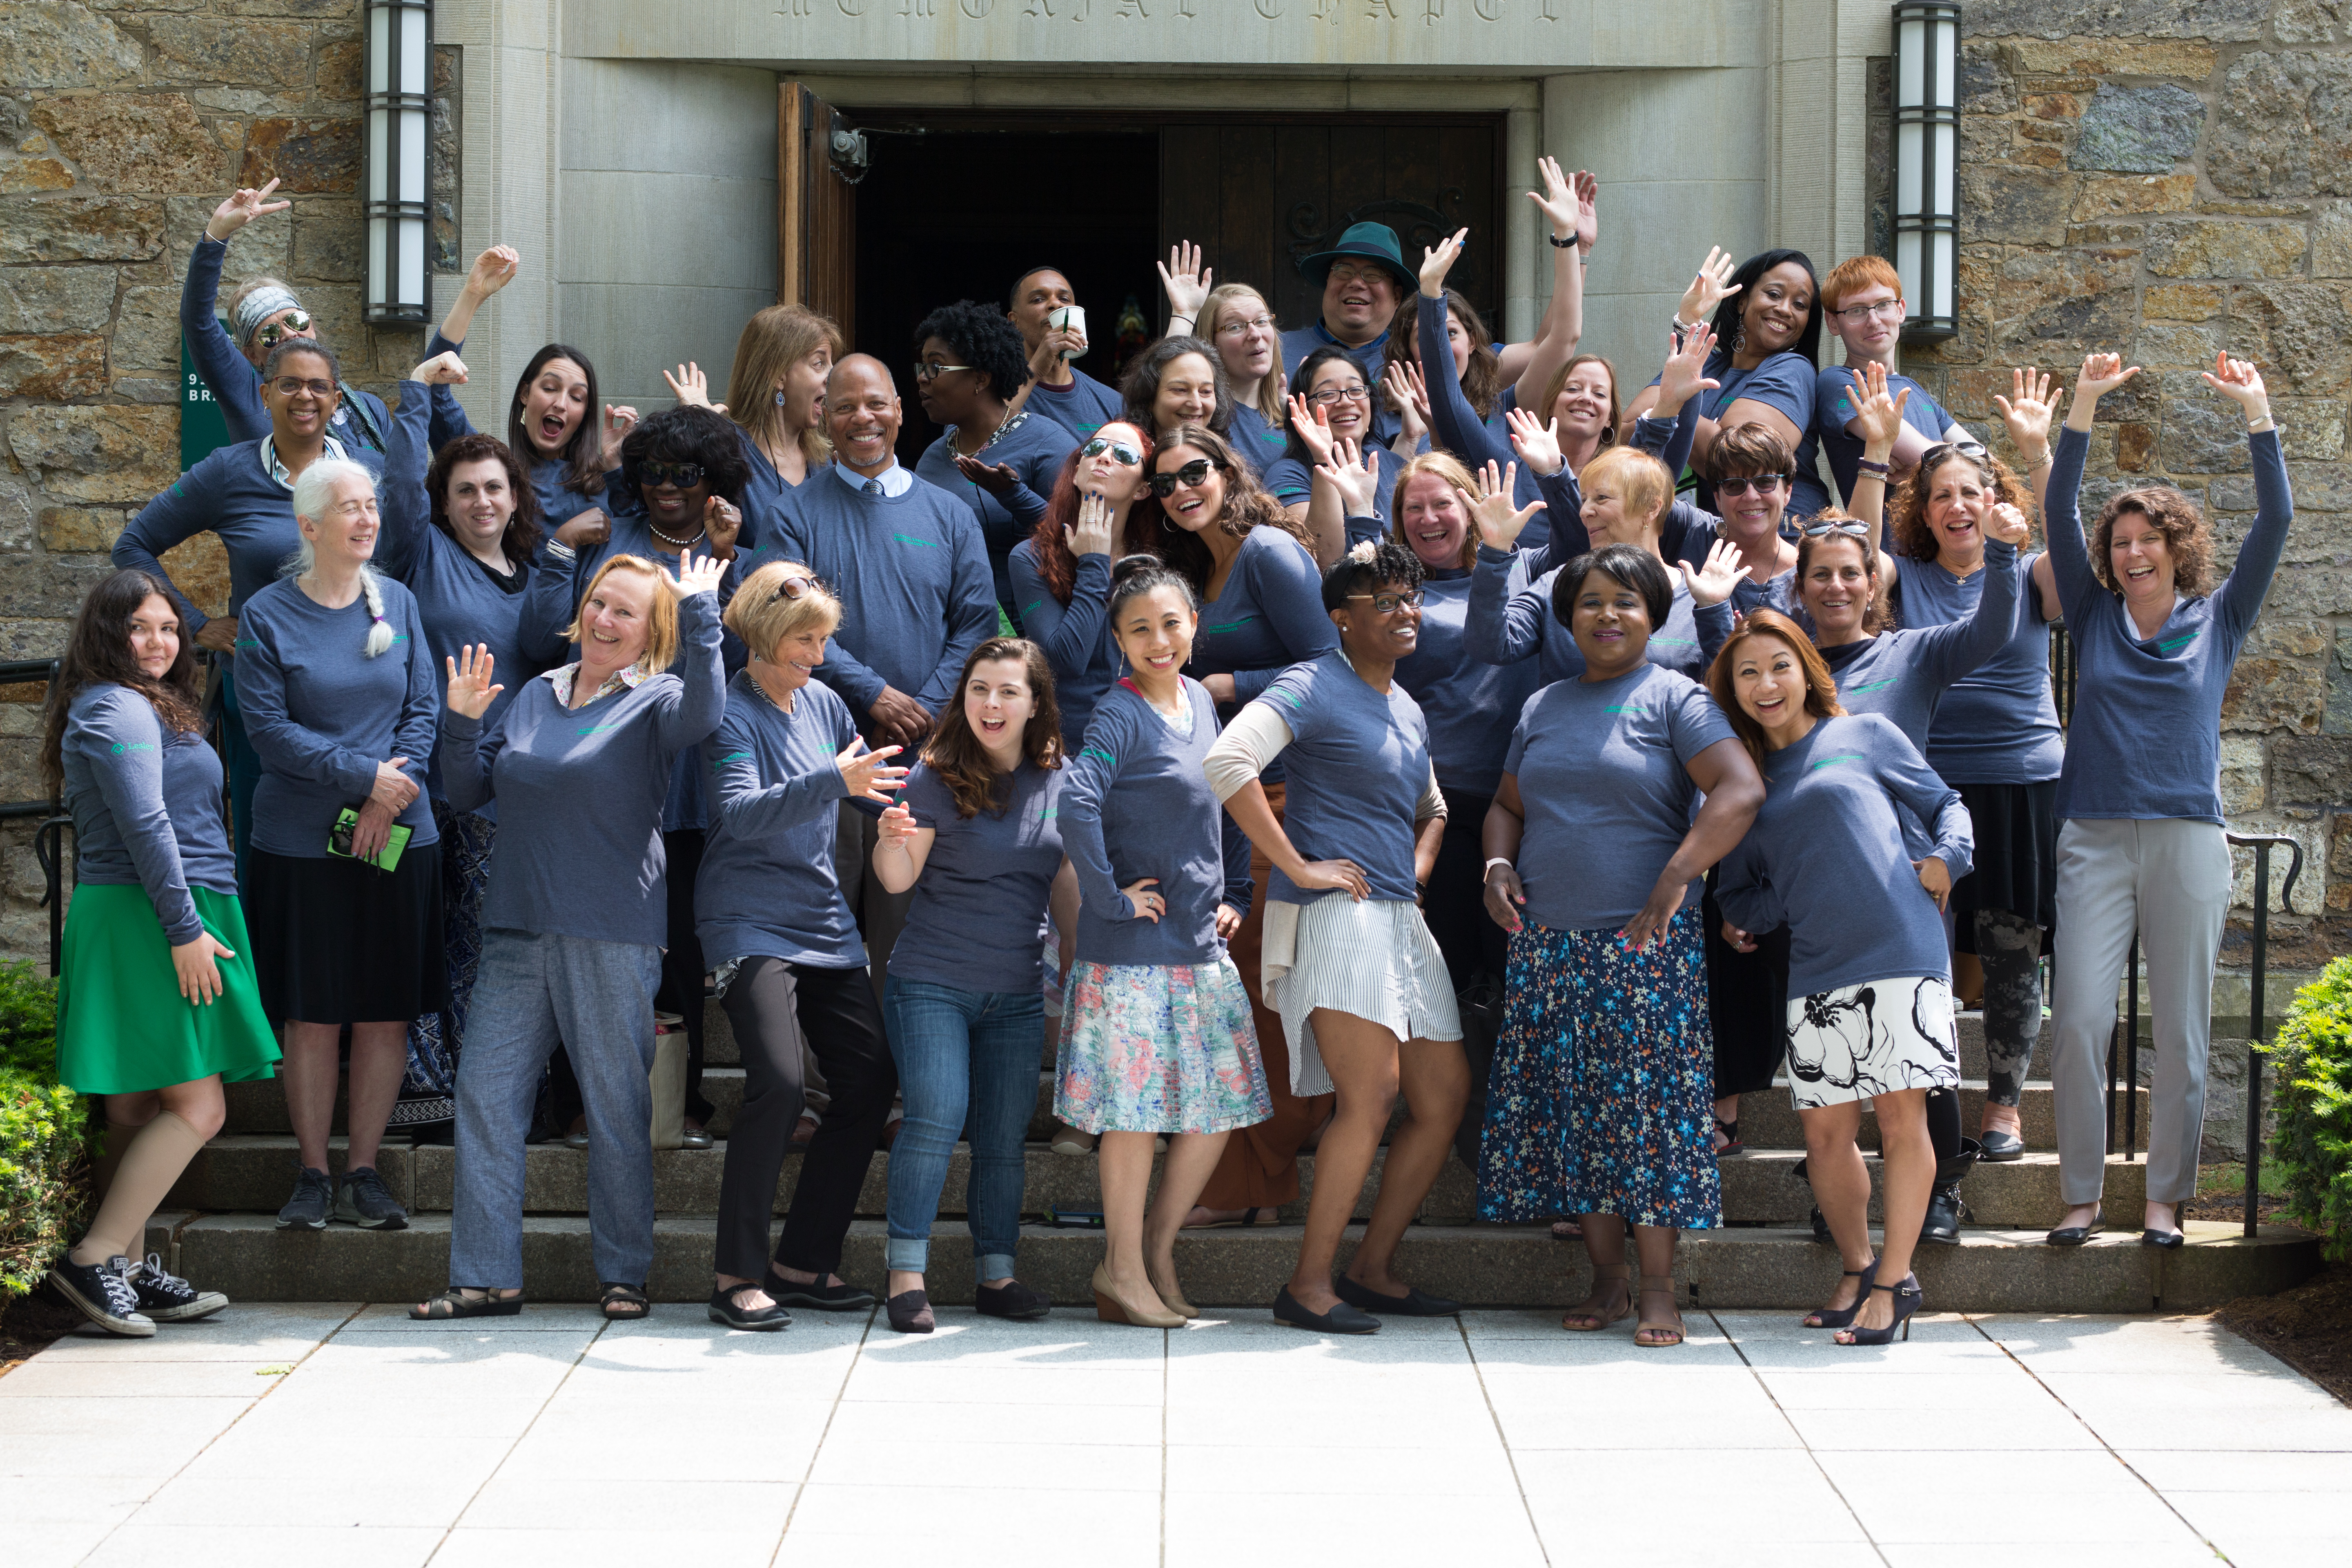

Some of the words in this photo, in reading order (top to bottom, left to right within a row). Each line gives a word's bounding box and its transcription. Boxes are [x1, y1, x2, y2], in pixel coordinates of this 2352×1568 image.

[1274, 486, 1301, 496] Lesley
[1022, 600, 1041, 616] Lesley
[1224, 617, 1252, 628] ADMISSIONS
[2176, 631, 2201, 642] ADMISSIONS
[238, 639, 259, 647] Lesley
[2161, 640, 2189, 652] AMBASSADOR
[1277, 687, 1302, 707] Lesley
[127, 742, 154, 751] Lesley
